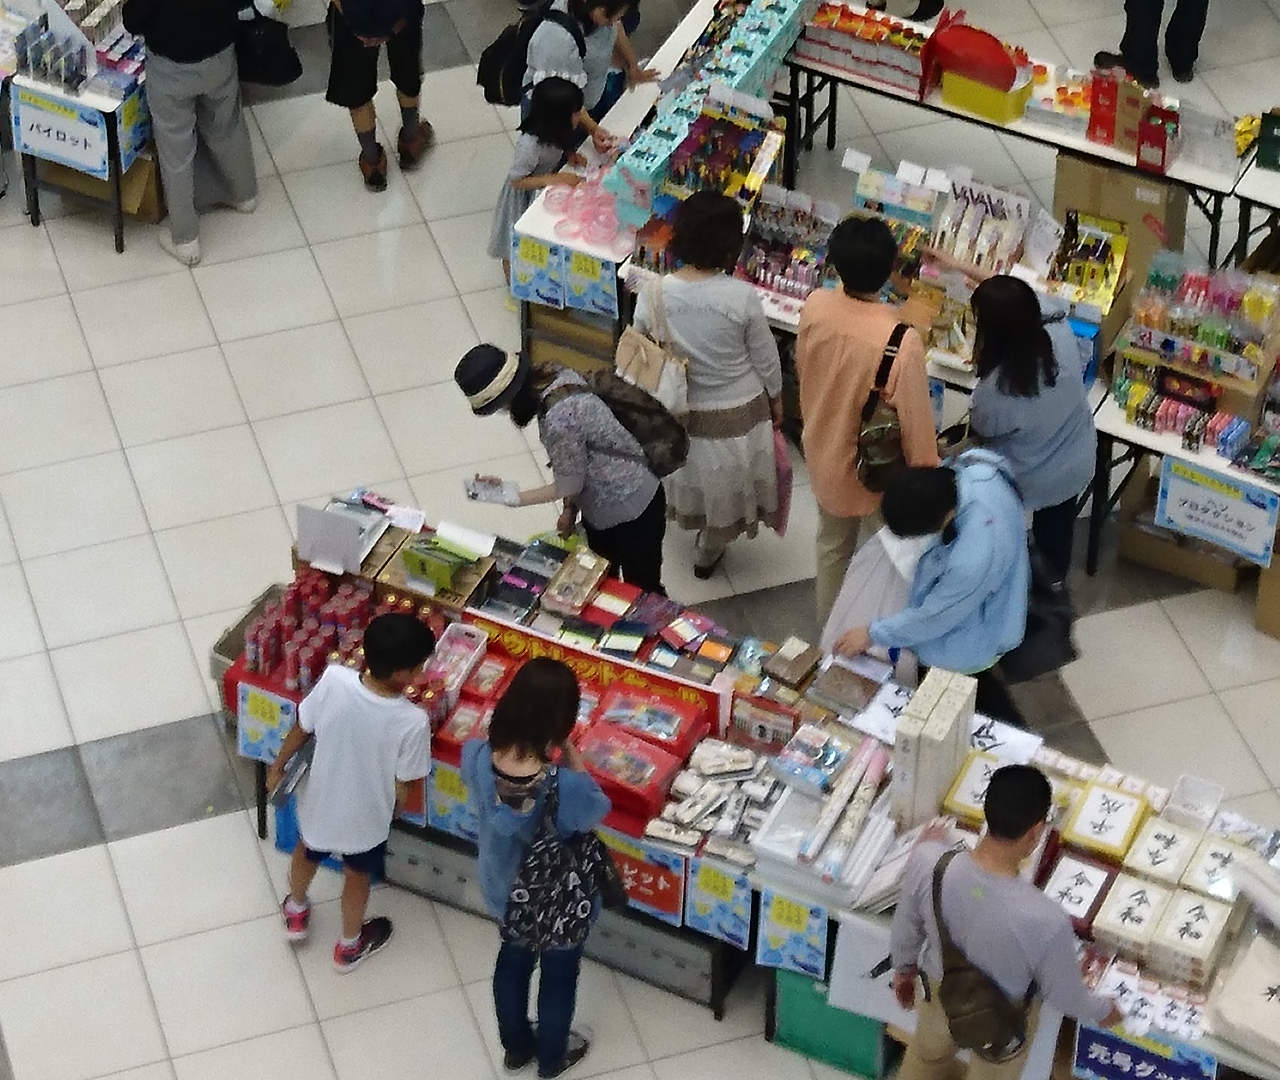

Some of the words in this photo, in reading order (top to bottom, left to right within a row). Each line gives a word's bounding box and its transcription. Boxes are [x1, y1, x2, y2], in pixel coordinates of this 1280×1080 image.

[28, 122, 93, 151] パイロット
[1057, 870, 1094, 906] 令和
[1118, 888, 1152, 925] 令和
[1176, 903, 1211, 941] 令和
